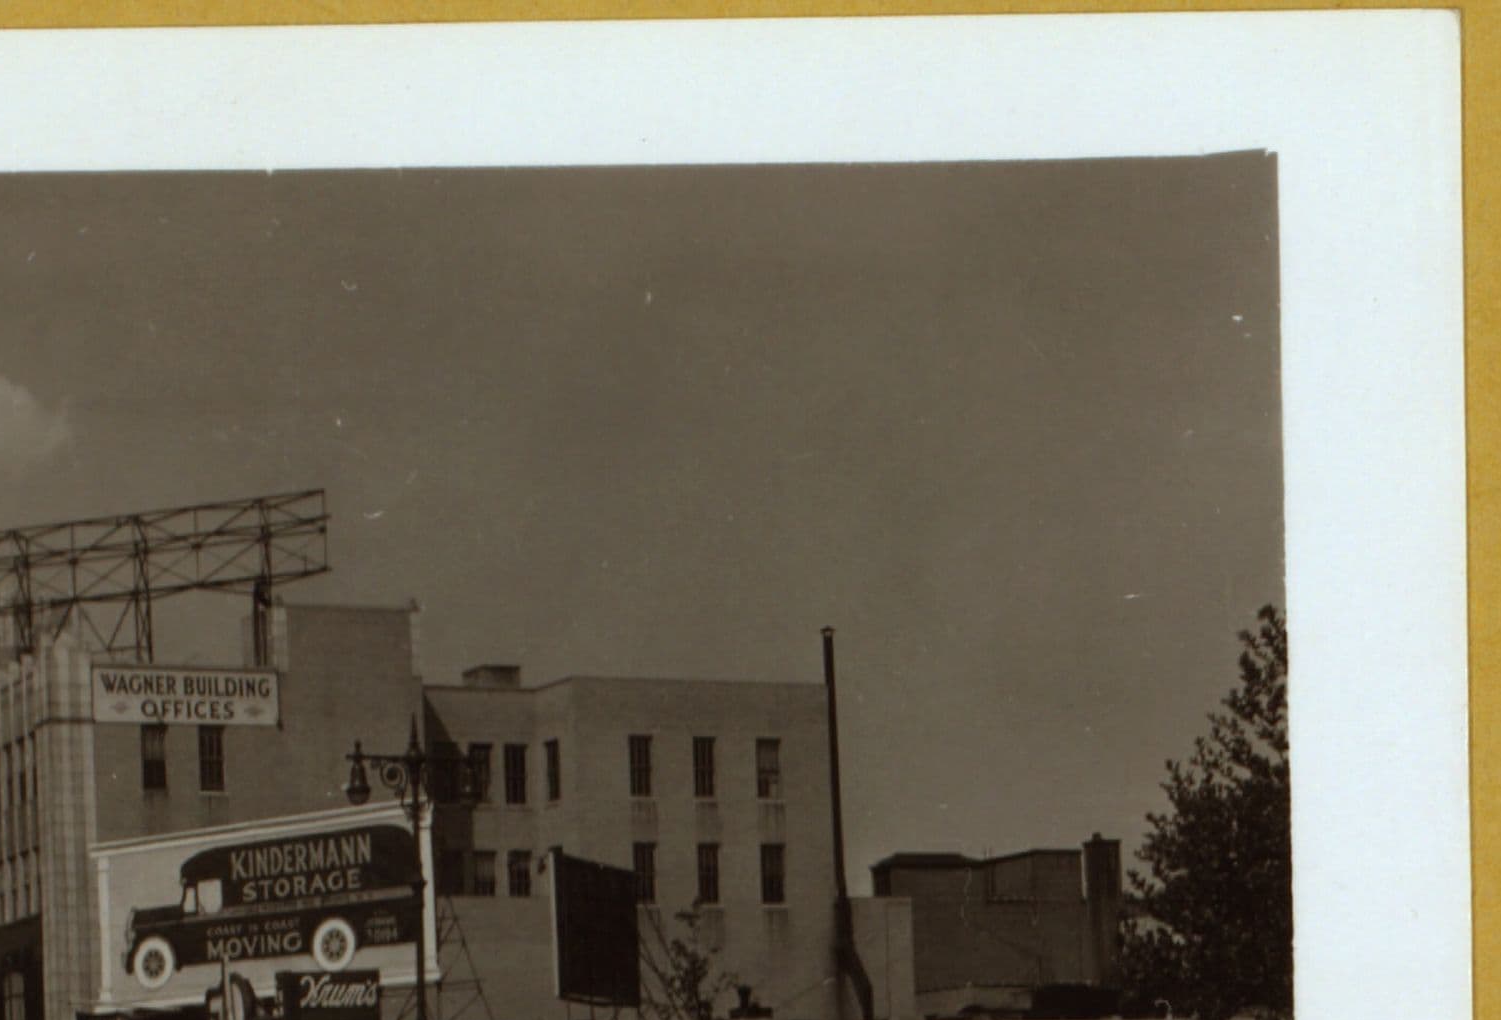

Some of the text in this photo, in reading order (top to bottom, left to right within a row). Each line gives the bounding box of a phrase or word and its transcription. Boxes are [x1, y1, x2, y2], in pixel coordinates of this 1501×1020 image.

[100, 673, 271, 699] WAGNER BUILDING
[140, 699, 235, 720] OFFICES
[230, 833, 372, 880] KINDERMANN
[242, 868, 363, 902] STORAGE
[206, 931, 303, 961] MOVING
[300, 974, 378, 1008] Krum's
